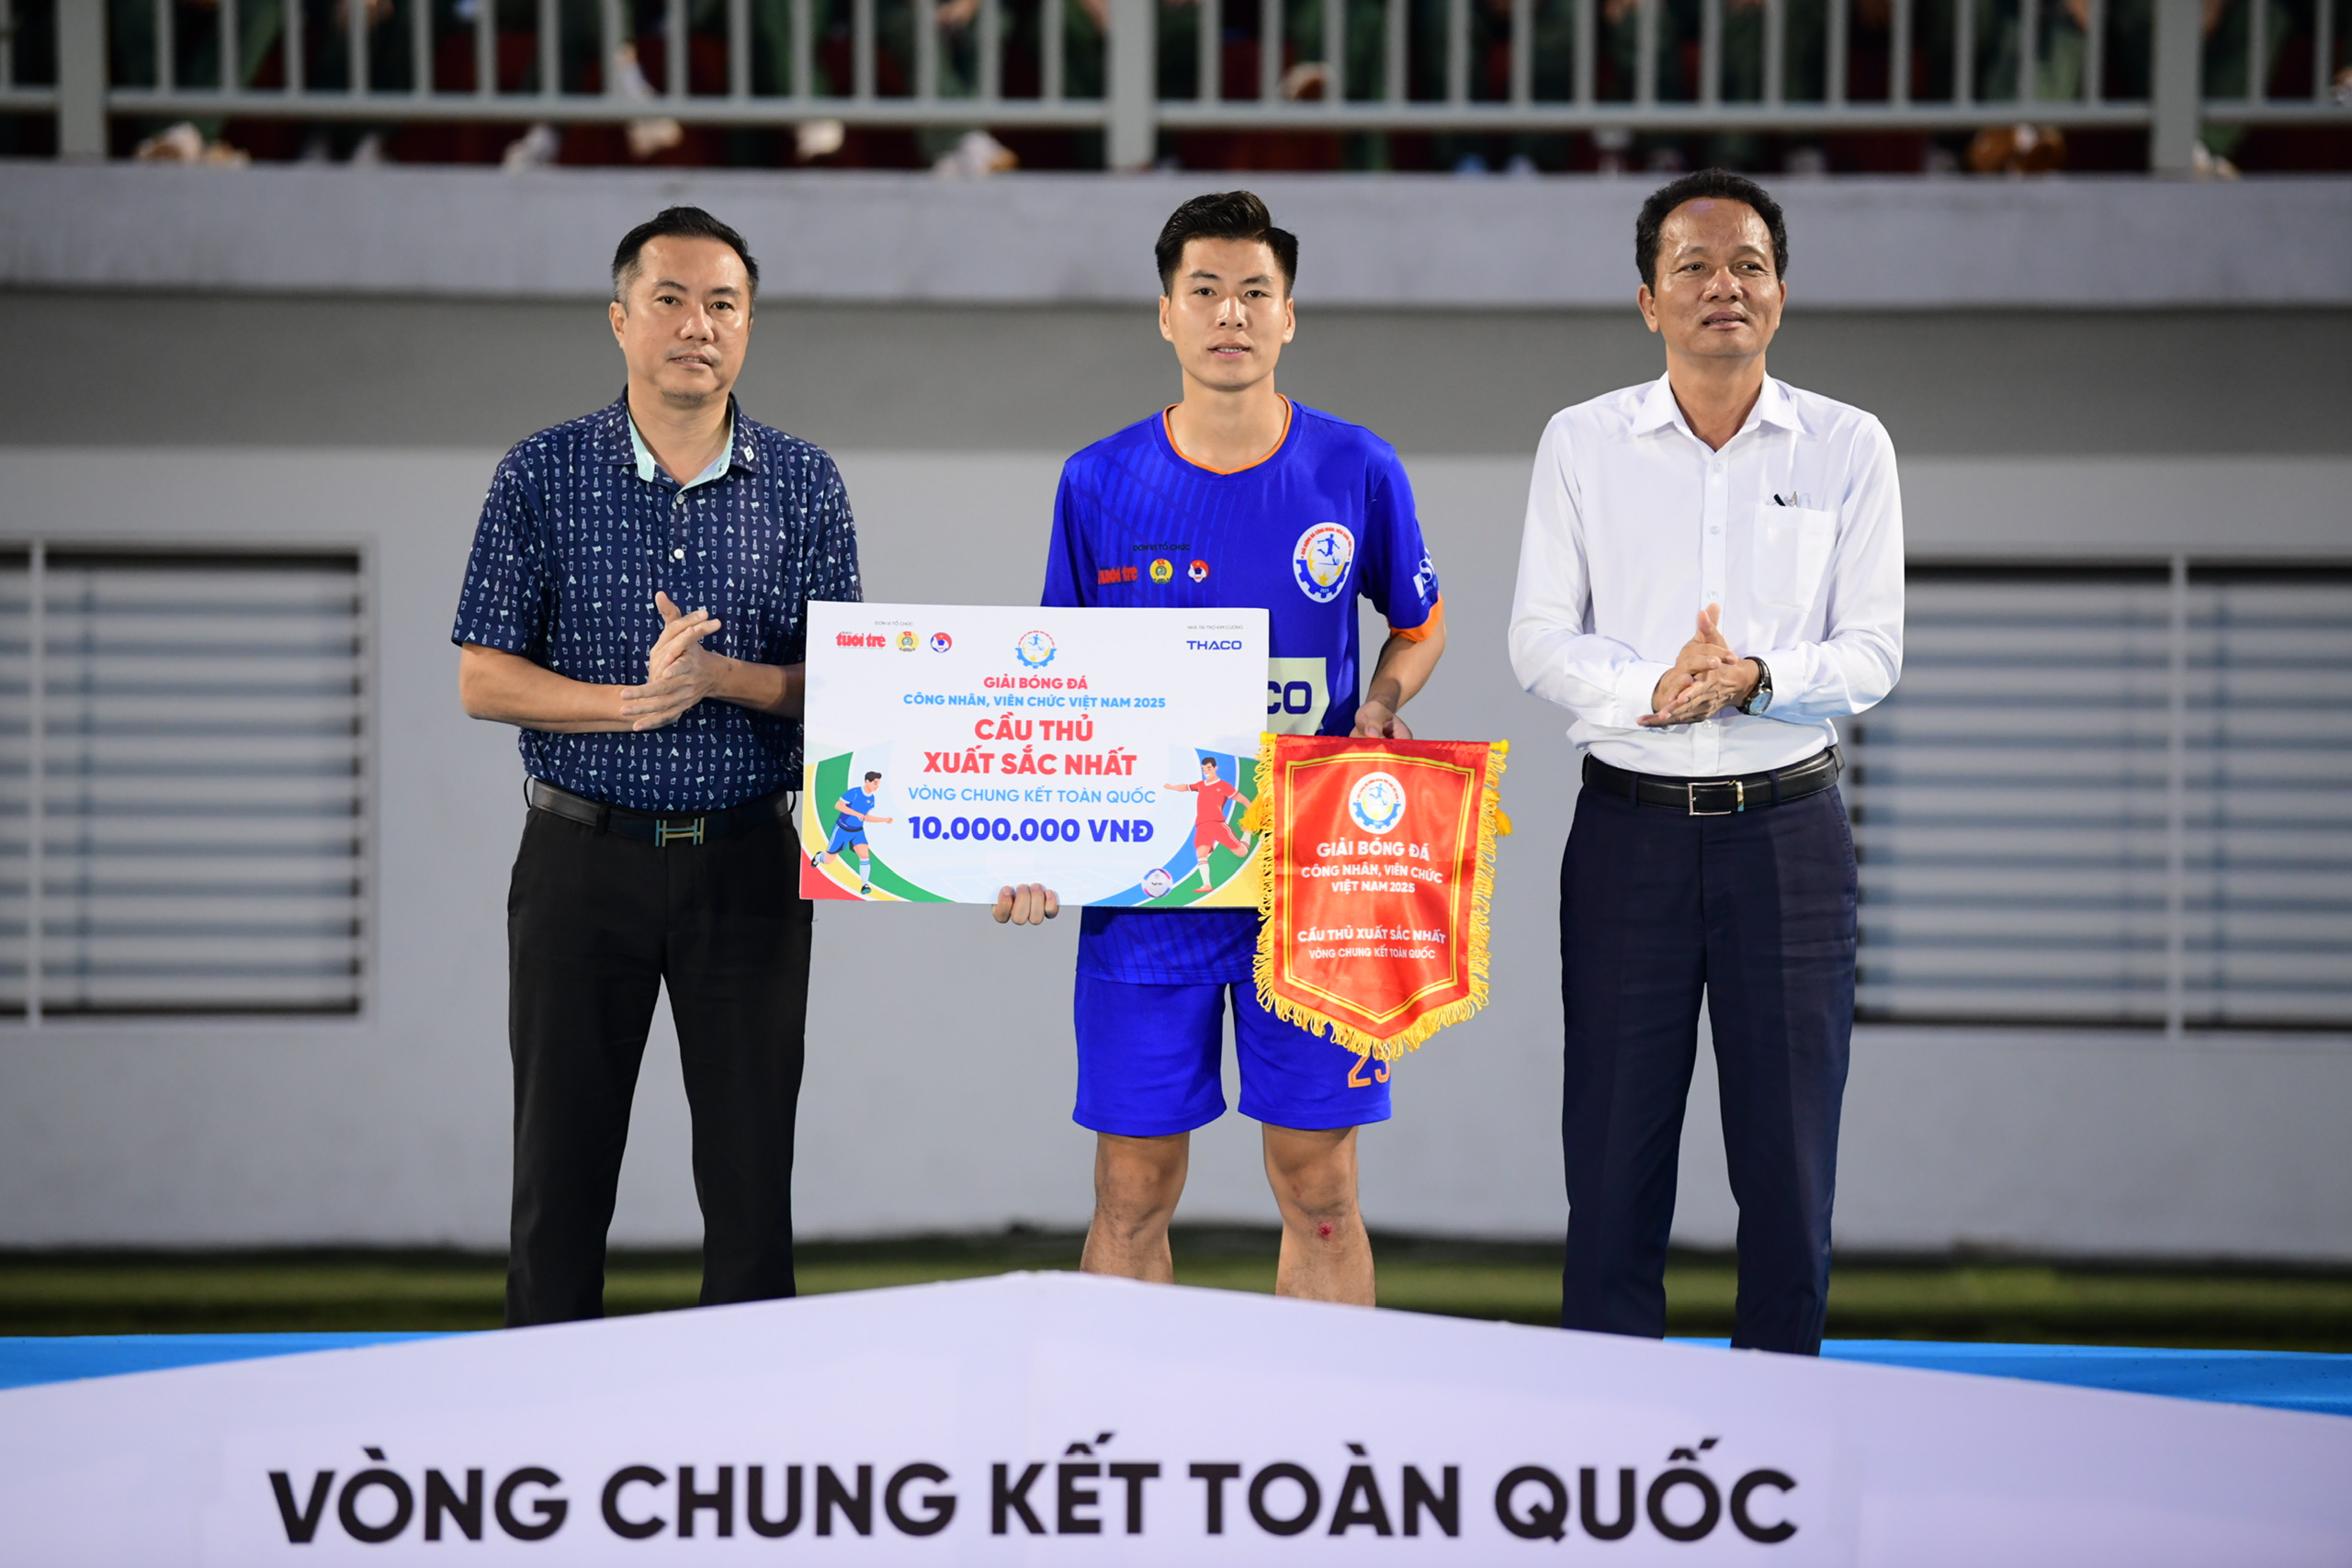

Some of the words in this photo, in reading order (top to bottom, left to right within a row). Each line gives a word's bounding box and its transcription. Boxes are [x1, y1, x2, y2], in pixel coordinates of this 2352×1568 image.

[1186, 640, 1242, 650] THACO
[983, 673, 1015, 689] GIẢI
[1019, 674, 1063, 690] BÓNG
[1067, 676, 1089, 690] ĐÁ
[903, 693, 945, 705] CÔNG
[948, 694, 989, 707] NHÂN,
[993, 694, 1024, 707] VIÊN
[1027, 694, 1066, 707] CHỨC
[1069, 695, 1099, 710] VIỆT
[1101, 698, 1131, 707] NAM
[1134, 698, 1166, 708] 2025
[975, 712, 1033, 740] CẦU
[1039, 715, 1093, 741] THỦ
[923, 745, 995, 774] XUẤT
[1001, 745, 1057, 775] SẮC
[1065, 747, 1137, 776] NHẤT
[908, 784, 956, 801] VÒNG
[961, 787, 1020, 803] CHUNG
[1024, 784, 1056, 803] KẾT
[1058, 786, 1102, 804] TOÀN
[1106, 784, 1157, 805] QUỐC
[908, 816, 1080, 842] 10.000.000
[1088, 819, 1154, 843] VNĐ
[1317, 836, 1353, 857] GIẢI
[1358, 837, 1405, 858] BÓNG
[1408, 842, 1430, 862] ĐÁ
[1301, 863, 1340, 879] CÔNG
[1342, 862, 1382, 877] NHÂN,
[1384, 863, 1408, 877] VIÊN
[1410, 864, 1443, 884] CHỨC
[1331, 879, 1359, 895] VIỆT
[1361, 882, 1387, 893] NAM
[1389, 882, 1416, 894] 2025
[1297, 926, 1326, 942] CẦU
[1327, 924, 1353, 941] THỦ
[1355, 925, 1388, 941] XUẤT
[1389, 925, 1410, 942] SẮC
[1412, 927, 1446, 944] NHẤT
[1309, 946, 1336, 959] VÒNG
[1338, 946, 1372, 958] CHUNG
[1374, 944, 1388, 958] KẾT
[1389, 946, 1407, 958] TOÀN
[1408, 944, 1435, 960] QUỐC
[268, 1447, 568, 1544] VÒNG
[601, 1462, 956, 1540] CHUNG
[990, 1432, 1160, 1535] KẾT
[1189, 1442, 1459, 1537] TOÀN
[1494, 1438, 1798, 1544] QUỐC
